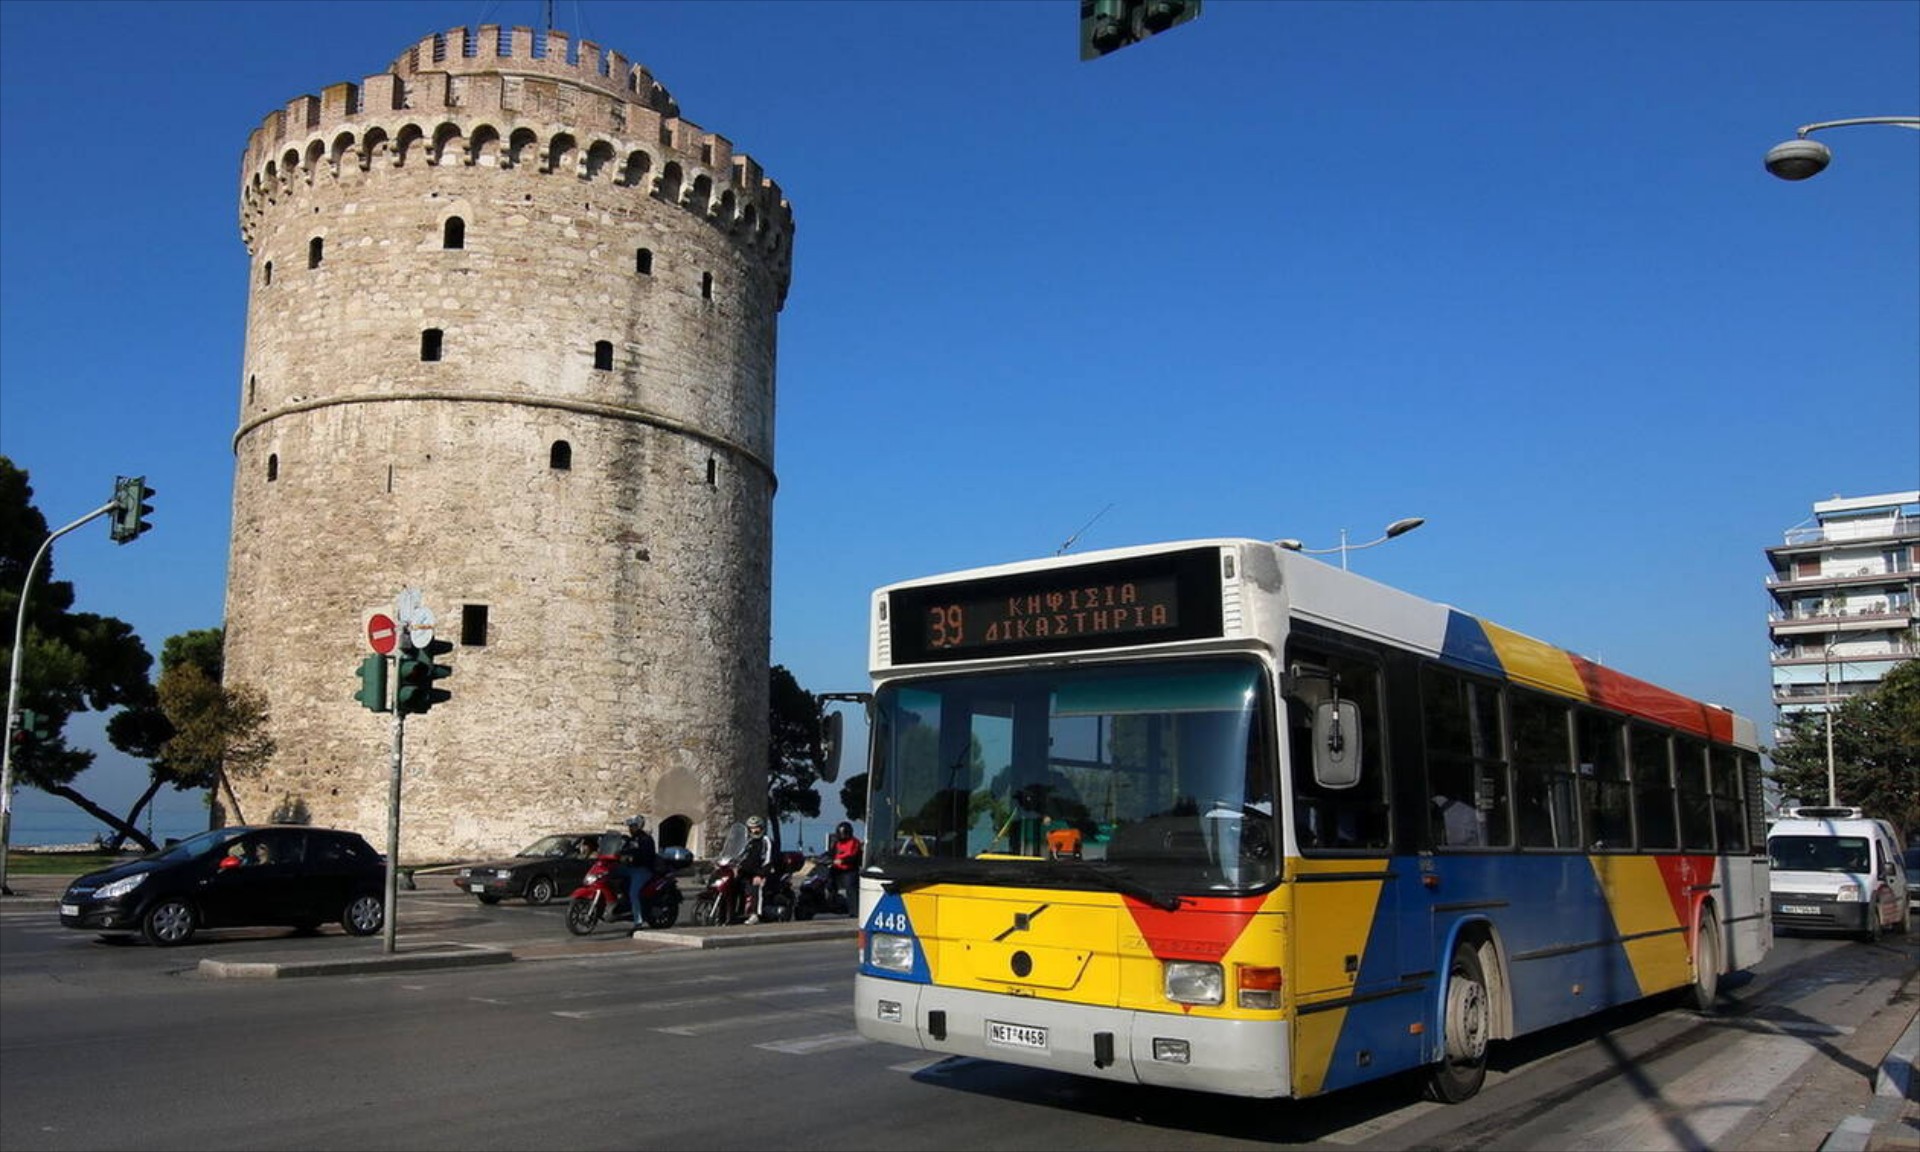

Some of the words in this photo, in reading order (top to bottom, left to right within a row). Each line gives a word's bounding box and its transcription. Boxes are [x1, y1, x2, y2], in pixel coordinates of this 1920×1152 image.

[1009, 583, 1136, 617] ΚΗΦΙΣΙΑ
[929, 605, 963, 647] 39
[985, 604, 1168, 641] ΔΙΚΑΣΤΗΡΙΑ
[874, 911, 906, 932] 448
